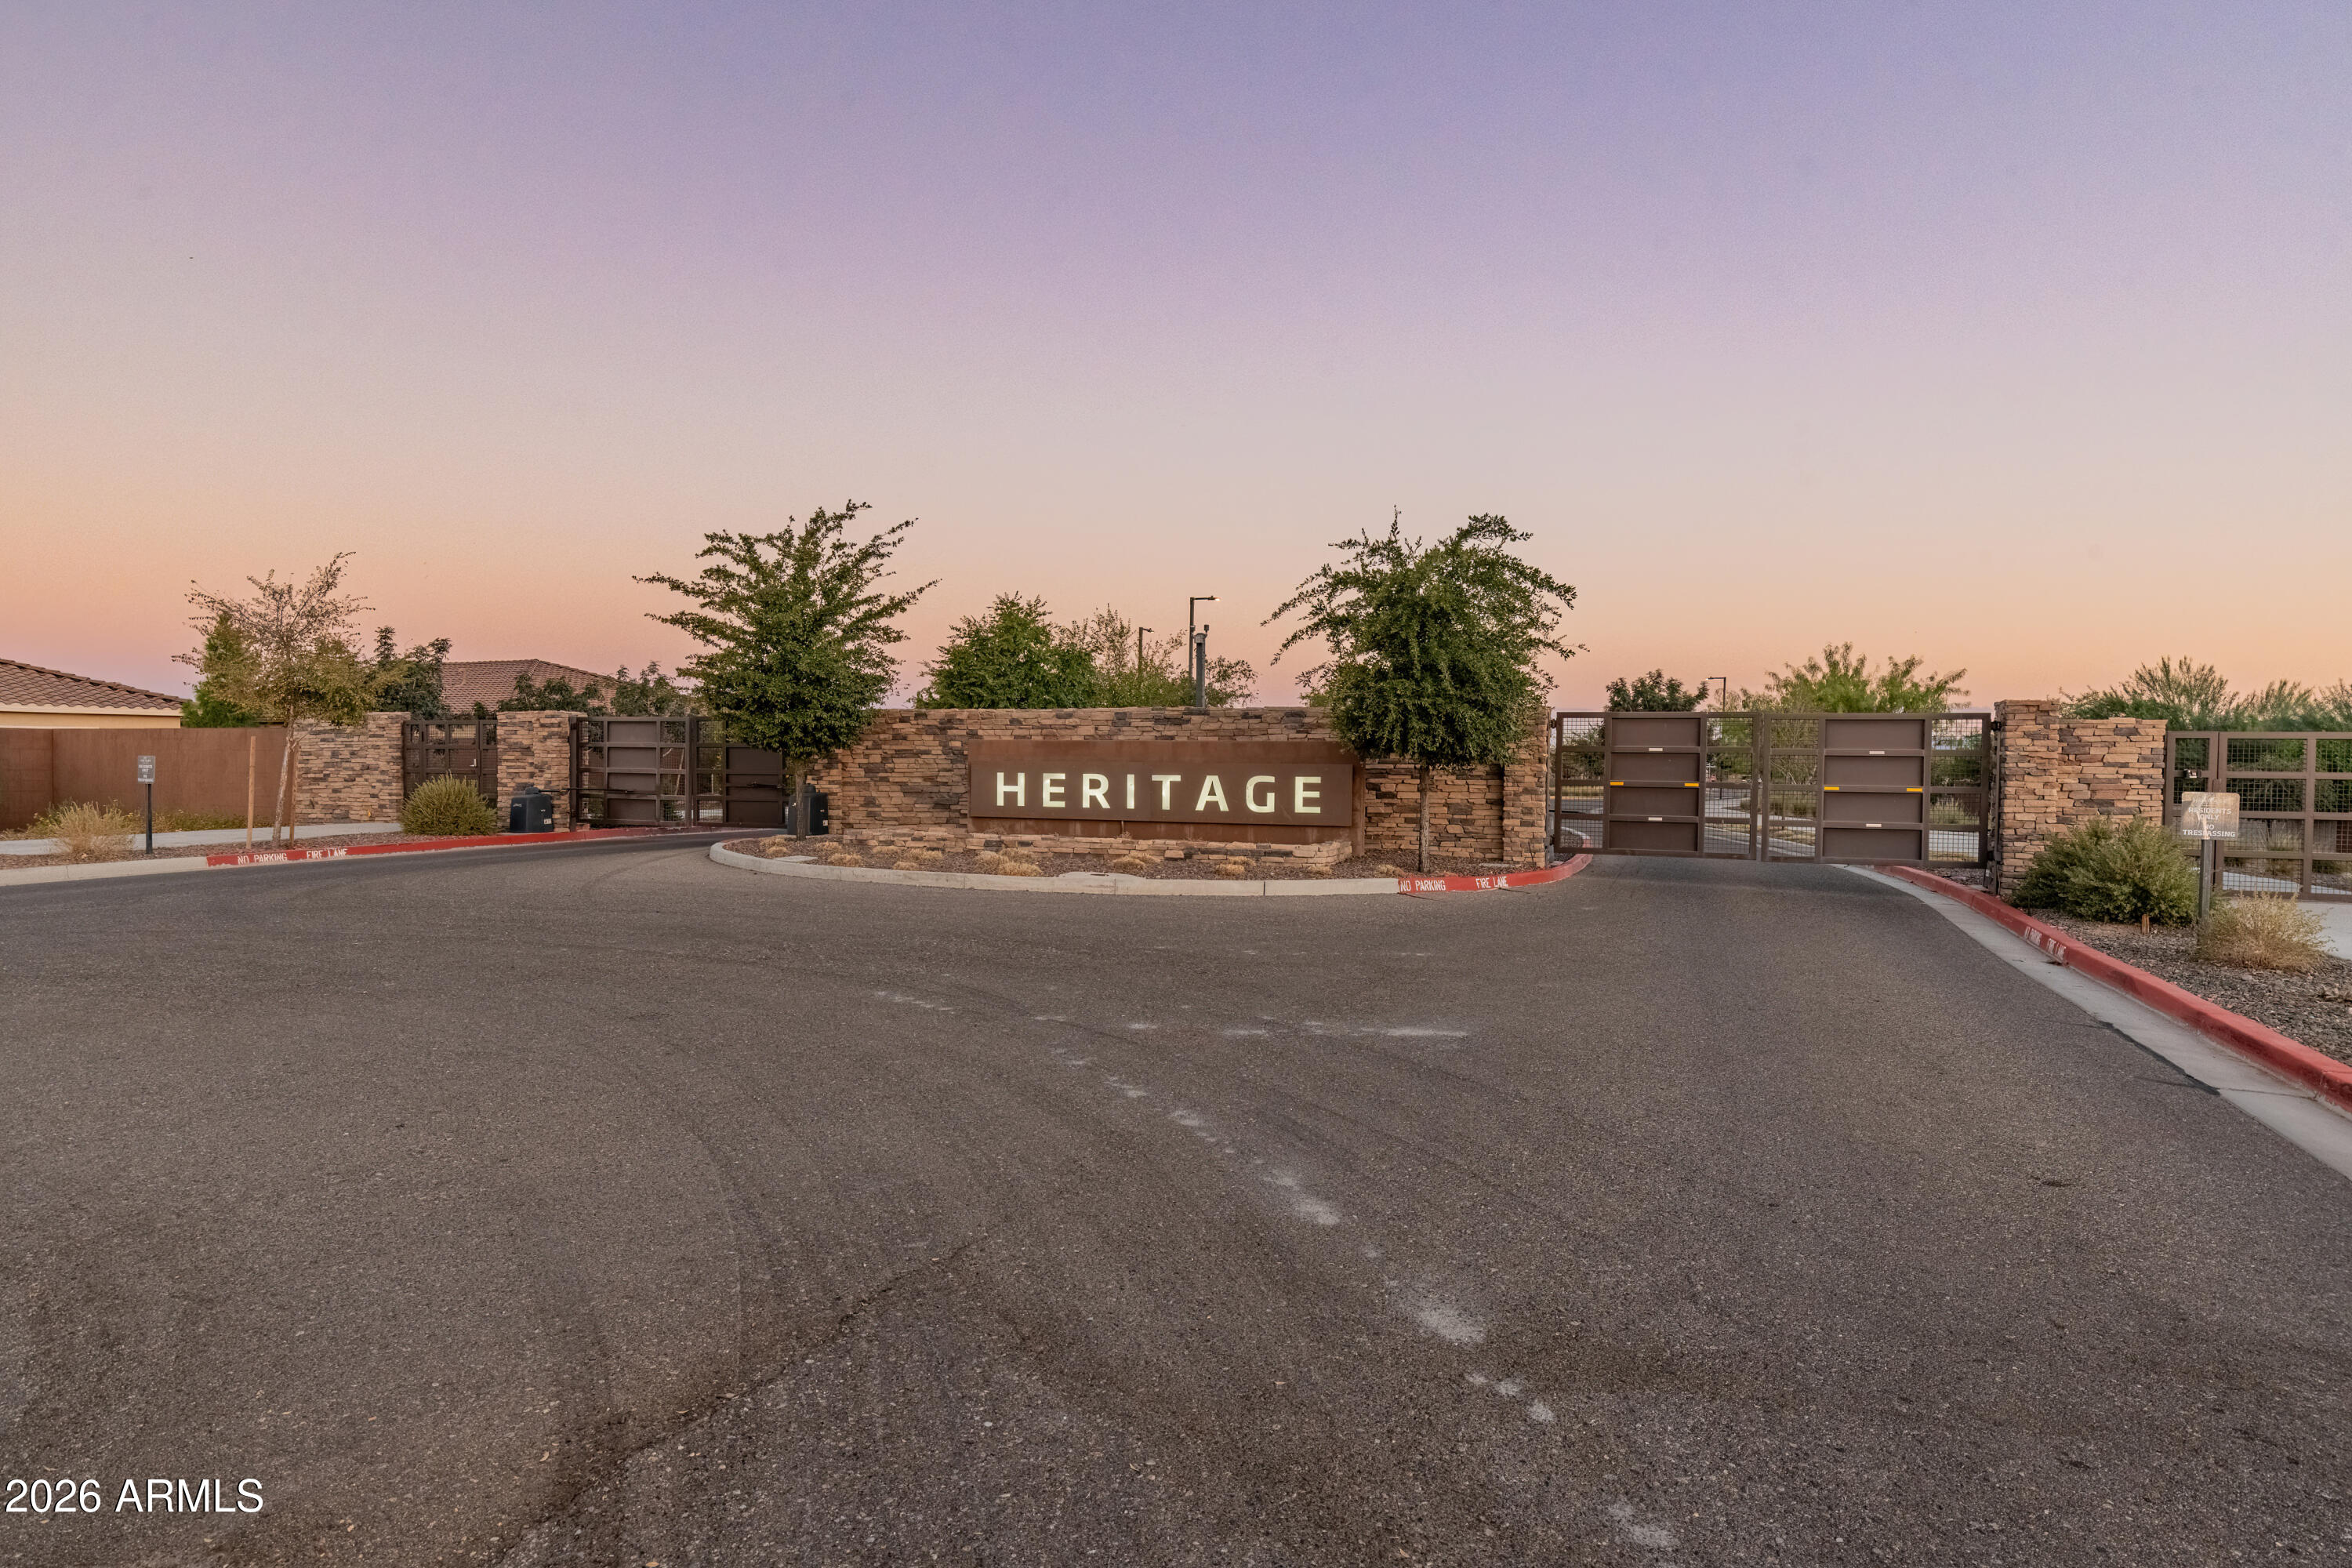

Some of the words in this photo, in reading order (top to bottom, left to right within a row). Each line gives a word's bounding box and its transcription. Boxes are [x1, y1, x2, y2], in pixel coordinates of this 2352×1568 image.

[996, 772, 1322, 814] HERITAGE
[238, 855, 249, 865] NO
[253, 853, 288, 863] PARKING
[307, 851, 323, 859] FIRE
[1400, 880, 1411, 892] NO
[1415, 879, 1446, 891] PARKING
[1475, 877, 1491, 889] FIRE
[1493, 876, 1508, 887] LANE
